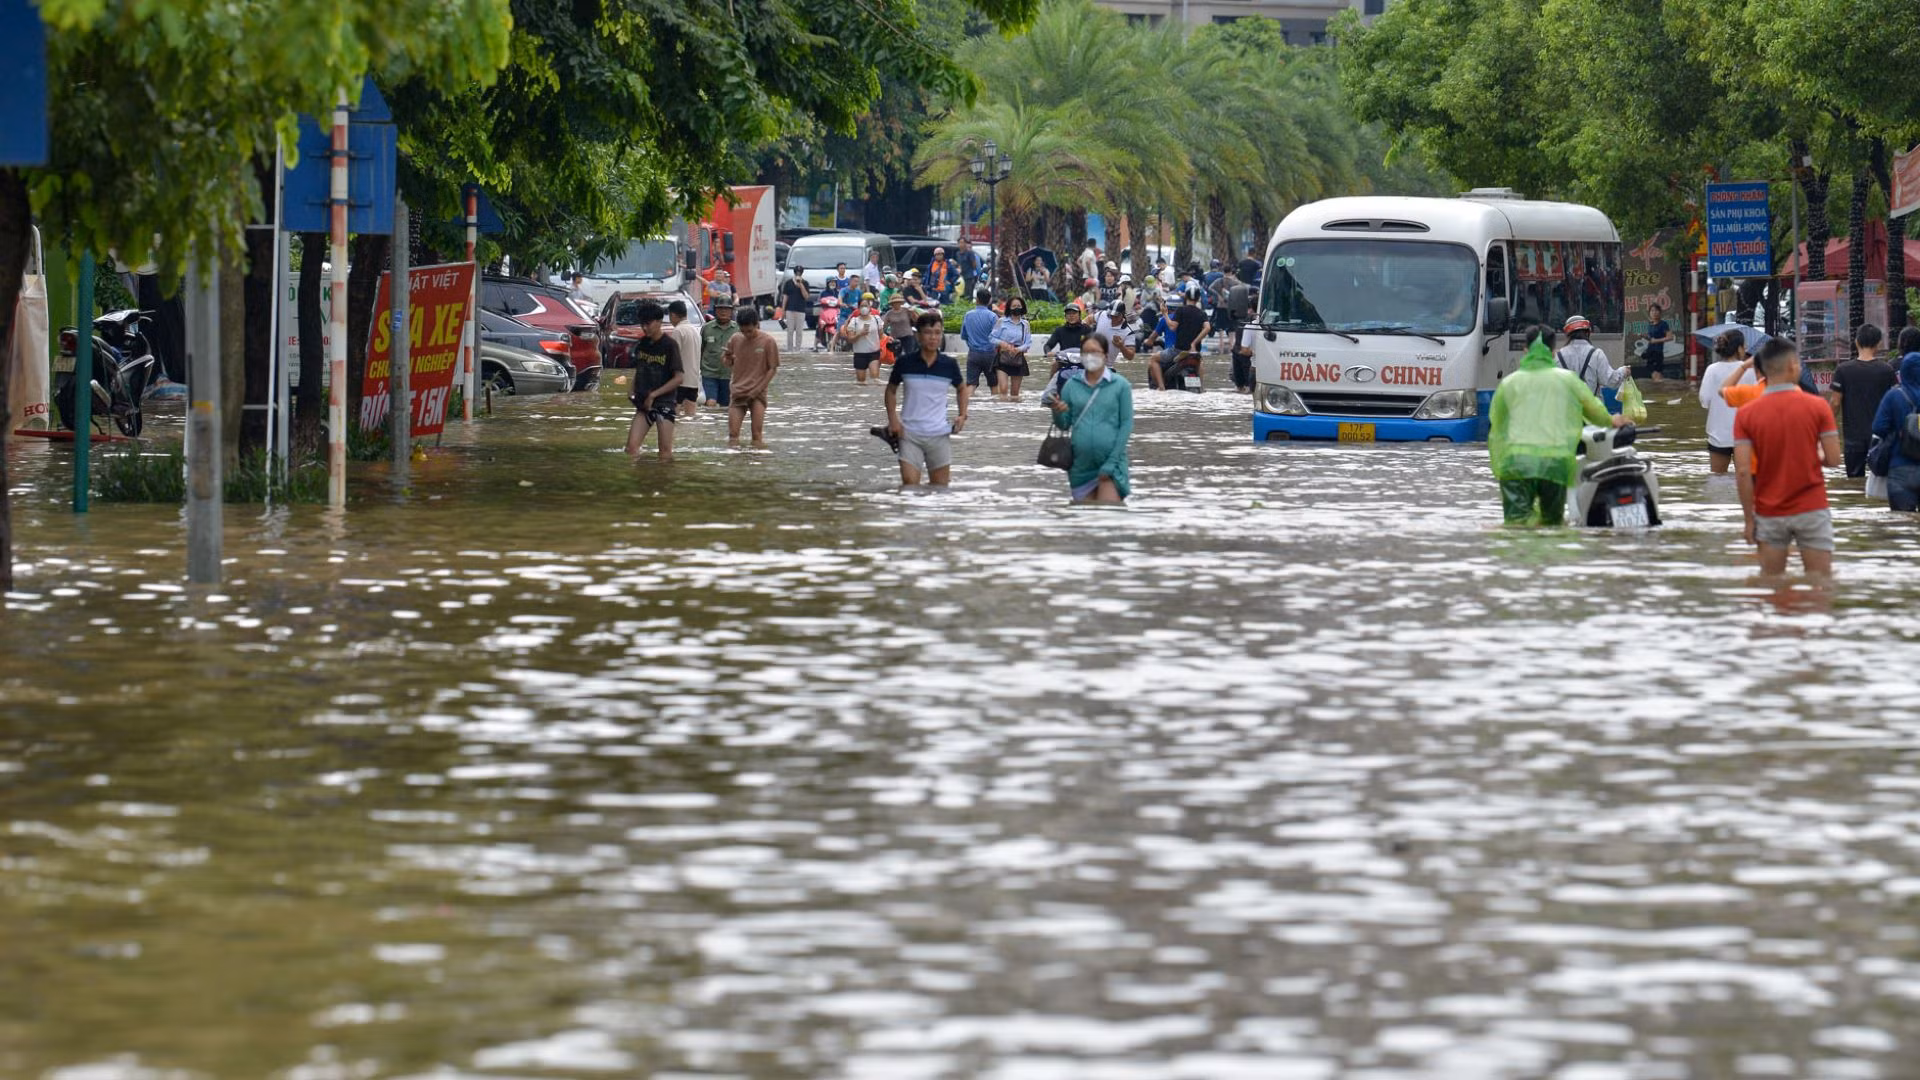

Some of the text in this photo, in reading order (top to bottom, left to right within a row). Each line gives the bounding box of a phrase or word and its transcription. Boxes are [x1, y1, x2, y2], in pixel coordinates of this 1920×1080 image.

[1744, 207, 1767, 218] KHOA
[1711, 236, 1767, 256] NHÀ THUỐC
[1714, 259, 1767, 273] ĐỨC TÂM
[432, 269, 460, 290] VIỆT
[374, 303, 464, 353] SA XE
[415, 349, 456, 374] NGHIỆP
[1280, 357, 1443, 386] HOÀNG CHINH
[416, 386, 449, 428] 15K
